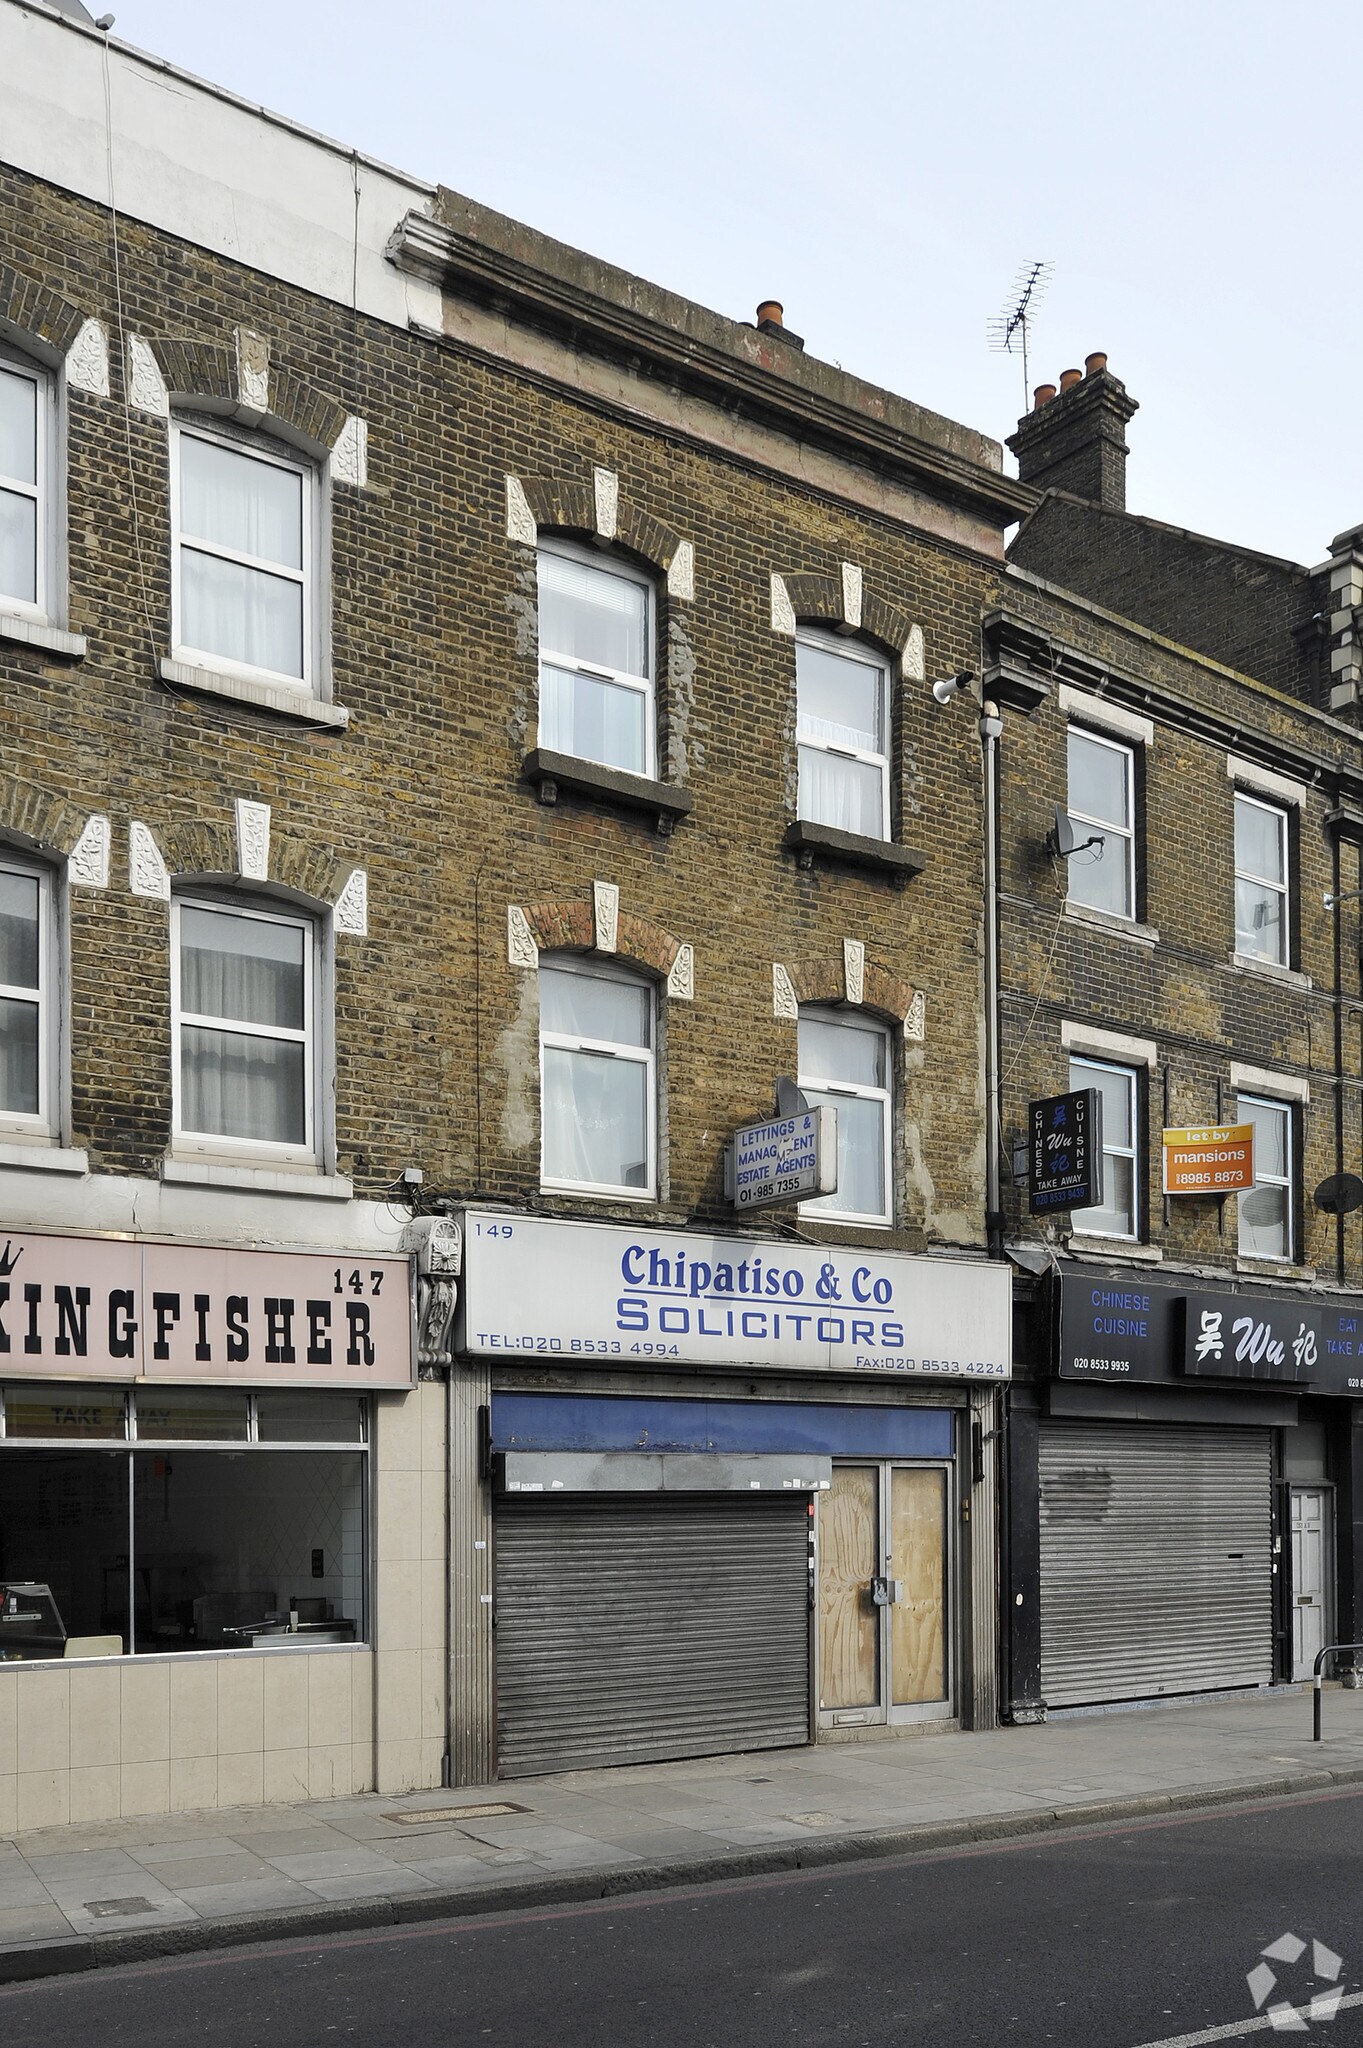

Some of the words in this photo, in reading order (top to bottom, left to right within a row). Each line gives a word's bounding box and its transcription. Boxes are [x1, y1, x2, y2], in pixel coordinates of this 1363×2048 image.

[742, 1120, 795, 1147] LETTINGS
[803, 1116, 811, 1129] &
[1186, 1131, 1208, 1141] let
[1213, 1130, 1230, 1142] by
[738, 1134, 814, 1166] MANAGENT
[1035, 1110, 1043, 1178] CHINESE
[1046, 1132, 1073, 1150] Wu
[1174, 1149, 1245, 1164] mansions
[737, 1165, 770, 1185] ESTATE
[775, 1153, 815, 1176] AGENTS
[1181, 1172, 1211, 1184] 8985
[1214, 1170, 1243, 1182] 8873
[777, 1177, 799, 1193] 7355
[1037, 1178, 1057, 1190] TAKE
[1061, 1174, 1082, 1186] AWAY
[475, 1223, 513, 1239] 149
[334, 1268, 384, 1295] 147
[621, 1245, 804, 1298] Chipatiso
[815, 1263, 842, 1300] &
[852, 1267, 893, 1304] Co
[1091, 1290, 1150, 1311] CHINESE
[616, 1298, 904, 1348] SOLICITORS
[1093, 1317, 1147, 1337] CUISINE
[1339, 1317, 1358, 1333] EAT
[477, 1333, 561, 1350] TEL:020
[570, 1339, 621, 1353] 8533
[630, 1342, 679, 1356] 4994
[1231, 1317, 1285, 1365] Wu
[1326, 1340, 1353, 1355] TAKE
[922, 1359, 960, 1372] 8533
[966, 1363, 1004, 1374] 4224
[1074, 1357, 1088, 1368] 020
[1090, 1358, 1109, 1370] 8533
[1111, 1361, 1130, 1371] 9935
[1348, 1378, 1360, 1387] 020
[51, 1407, 102, 1425] TAKE
